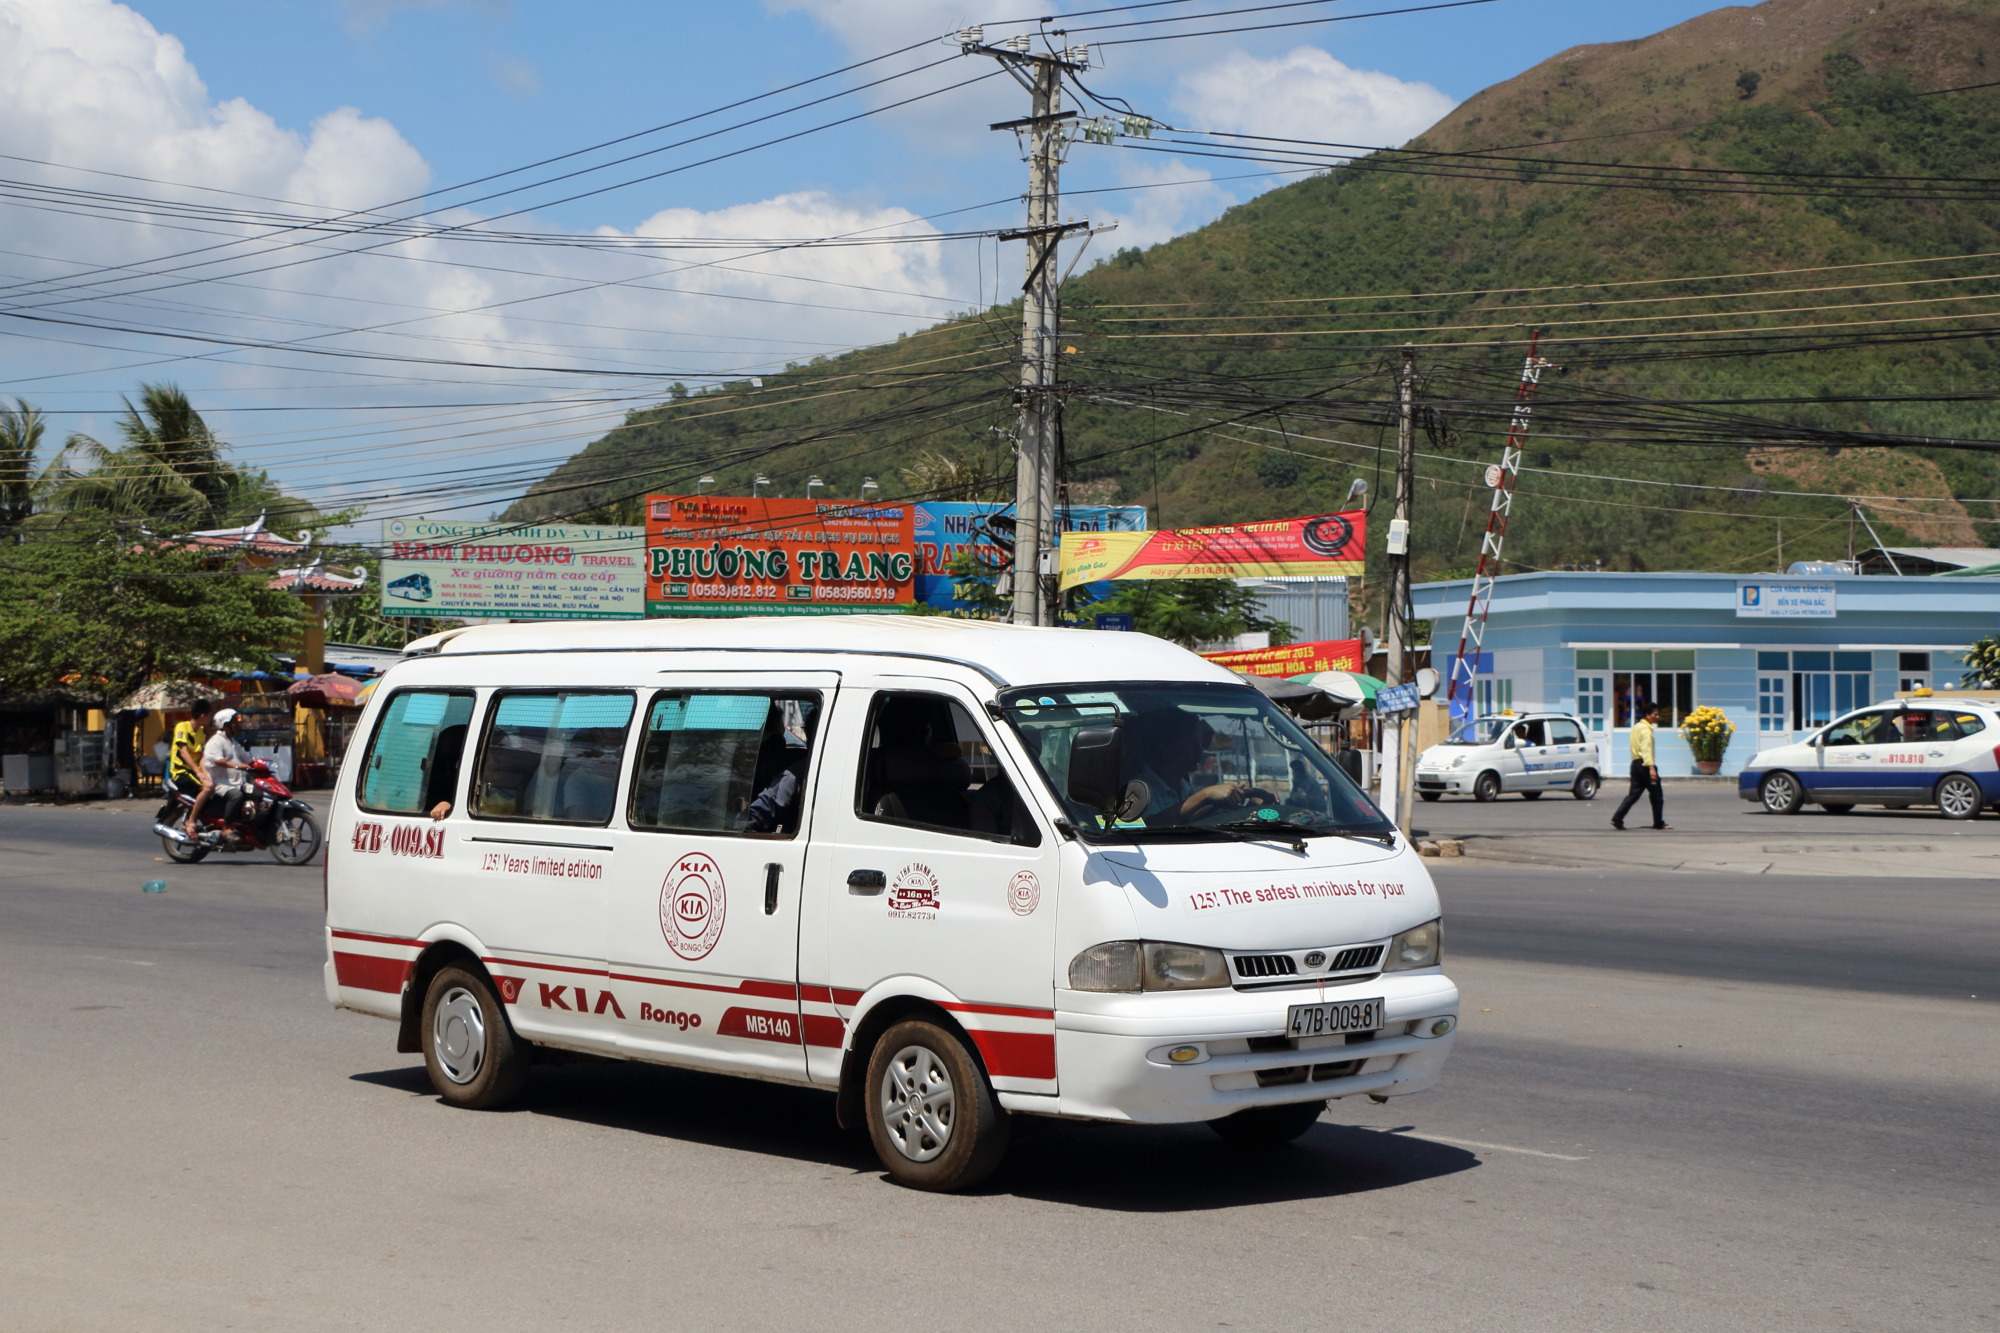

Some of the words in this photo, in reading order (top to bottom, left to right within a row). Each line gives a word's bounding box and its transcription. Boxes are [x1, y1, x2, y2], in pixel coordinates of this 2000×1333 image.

[416, 523, 462, 536] CÔNG
[546, 529, 568, 539] DV
[584, 530, 604, 540] VT
[697, 529, 709, 538] TY
[805, 531, 812, 540] &
[859, 533, 872, 542] DU
[876, 533, 900, 544] LỊCH
[392, 541, 457, 562] NAM
[461, 543, 575, 566] PHƯƠNG
[581, 555, 637, 568] TRAVEL
[650, 542, 788, 579] PHƯƠNG
[797, 551, 913, 581] TRANG
[450, 568, 472, 578] Xe
[472, 568, 522, 581] giường
[561, 572, 586, 580] cao
[590, 569, 617, 583] cấp
[1185, 566, 1235, 575] 3.814.814
[691, 582, 777, 599] (0583)812.812
[815, 585, 896, 600] (0583)560.919
[1790, 598, 1798, 606] XE
[1292, 646, 1315, 659] 2015
[1255, 664, 1284, 675] THANH
[1286, 660, 1306, 673] HÓA
[1314, 657, 1329, 671] HÀ
[1888, 753, 1924, 764] 810.810
[502, 854, 529, 873] Years
[531, 856, 564, 877] limited
[567, 859, 603, 879] edition
[680, 862, 712, 873] KIA
[1221, 888, 1253, 906] The
[1257, 884, 1301, 902] safest
[1301, 881, 1357, 899] minibus
[1357, 880, 1377, 895] for
[1378, 883, 1406, 900] your
[681, 899, 704, 915] KIA
[887, 910, 937, 920] 0917.827734
[680, 942, 702, 952] BONGO
[1308, 954, 1324, 966] KIA
[538, 981, 627, 1020] KIA
[640, 1002, 702, 1032] Bongo
[1291, 1001, 1381, 1034] 47B-009.81
[745, 1014, 792, 1038] MB140
